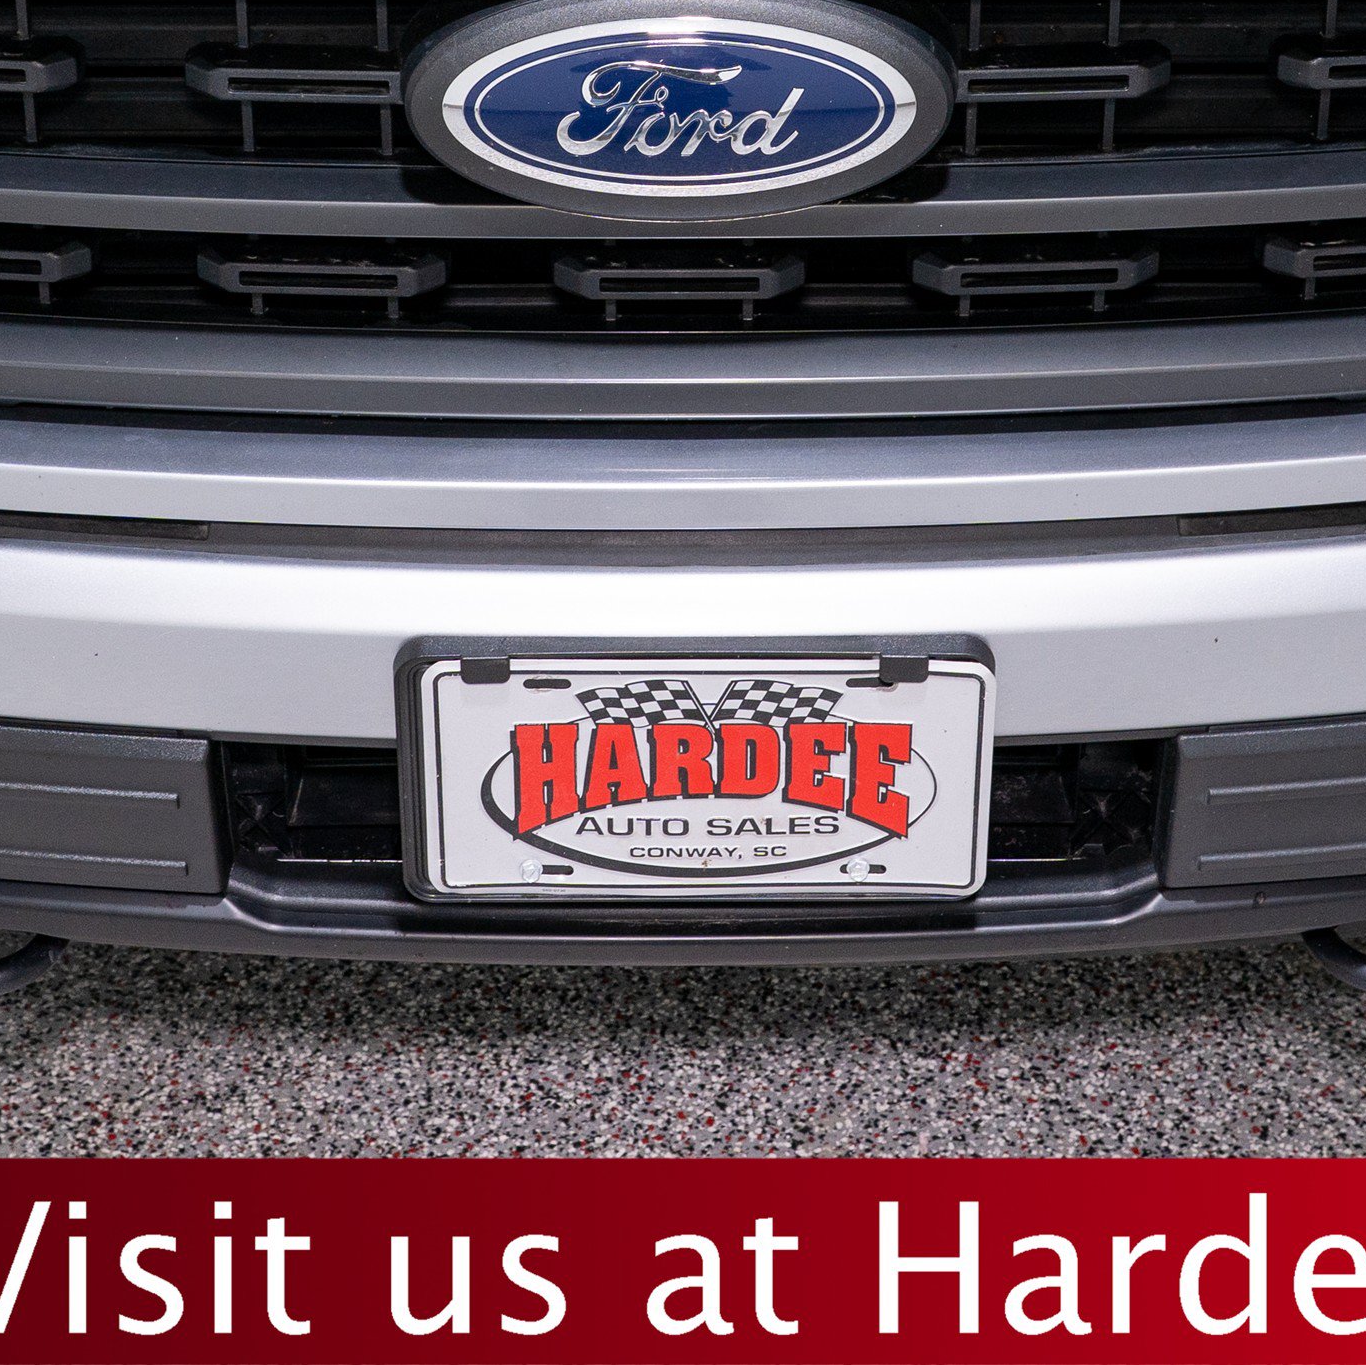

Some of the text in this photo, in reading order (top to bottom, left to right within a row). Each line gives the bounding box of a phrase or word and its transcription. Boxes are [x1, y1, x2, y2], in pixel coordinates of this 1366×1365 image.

[556, 59, 805, 158] Ford
[510, 722, 914, 841] HARDEE
[575, 815, 841, 837] AUTO SALES
[628, 845, 788, 860] CONWAY, SC
